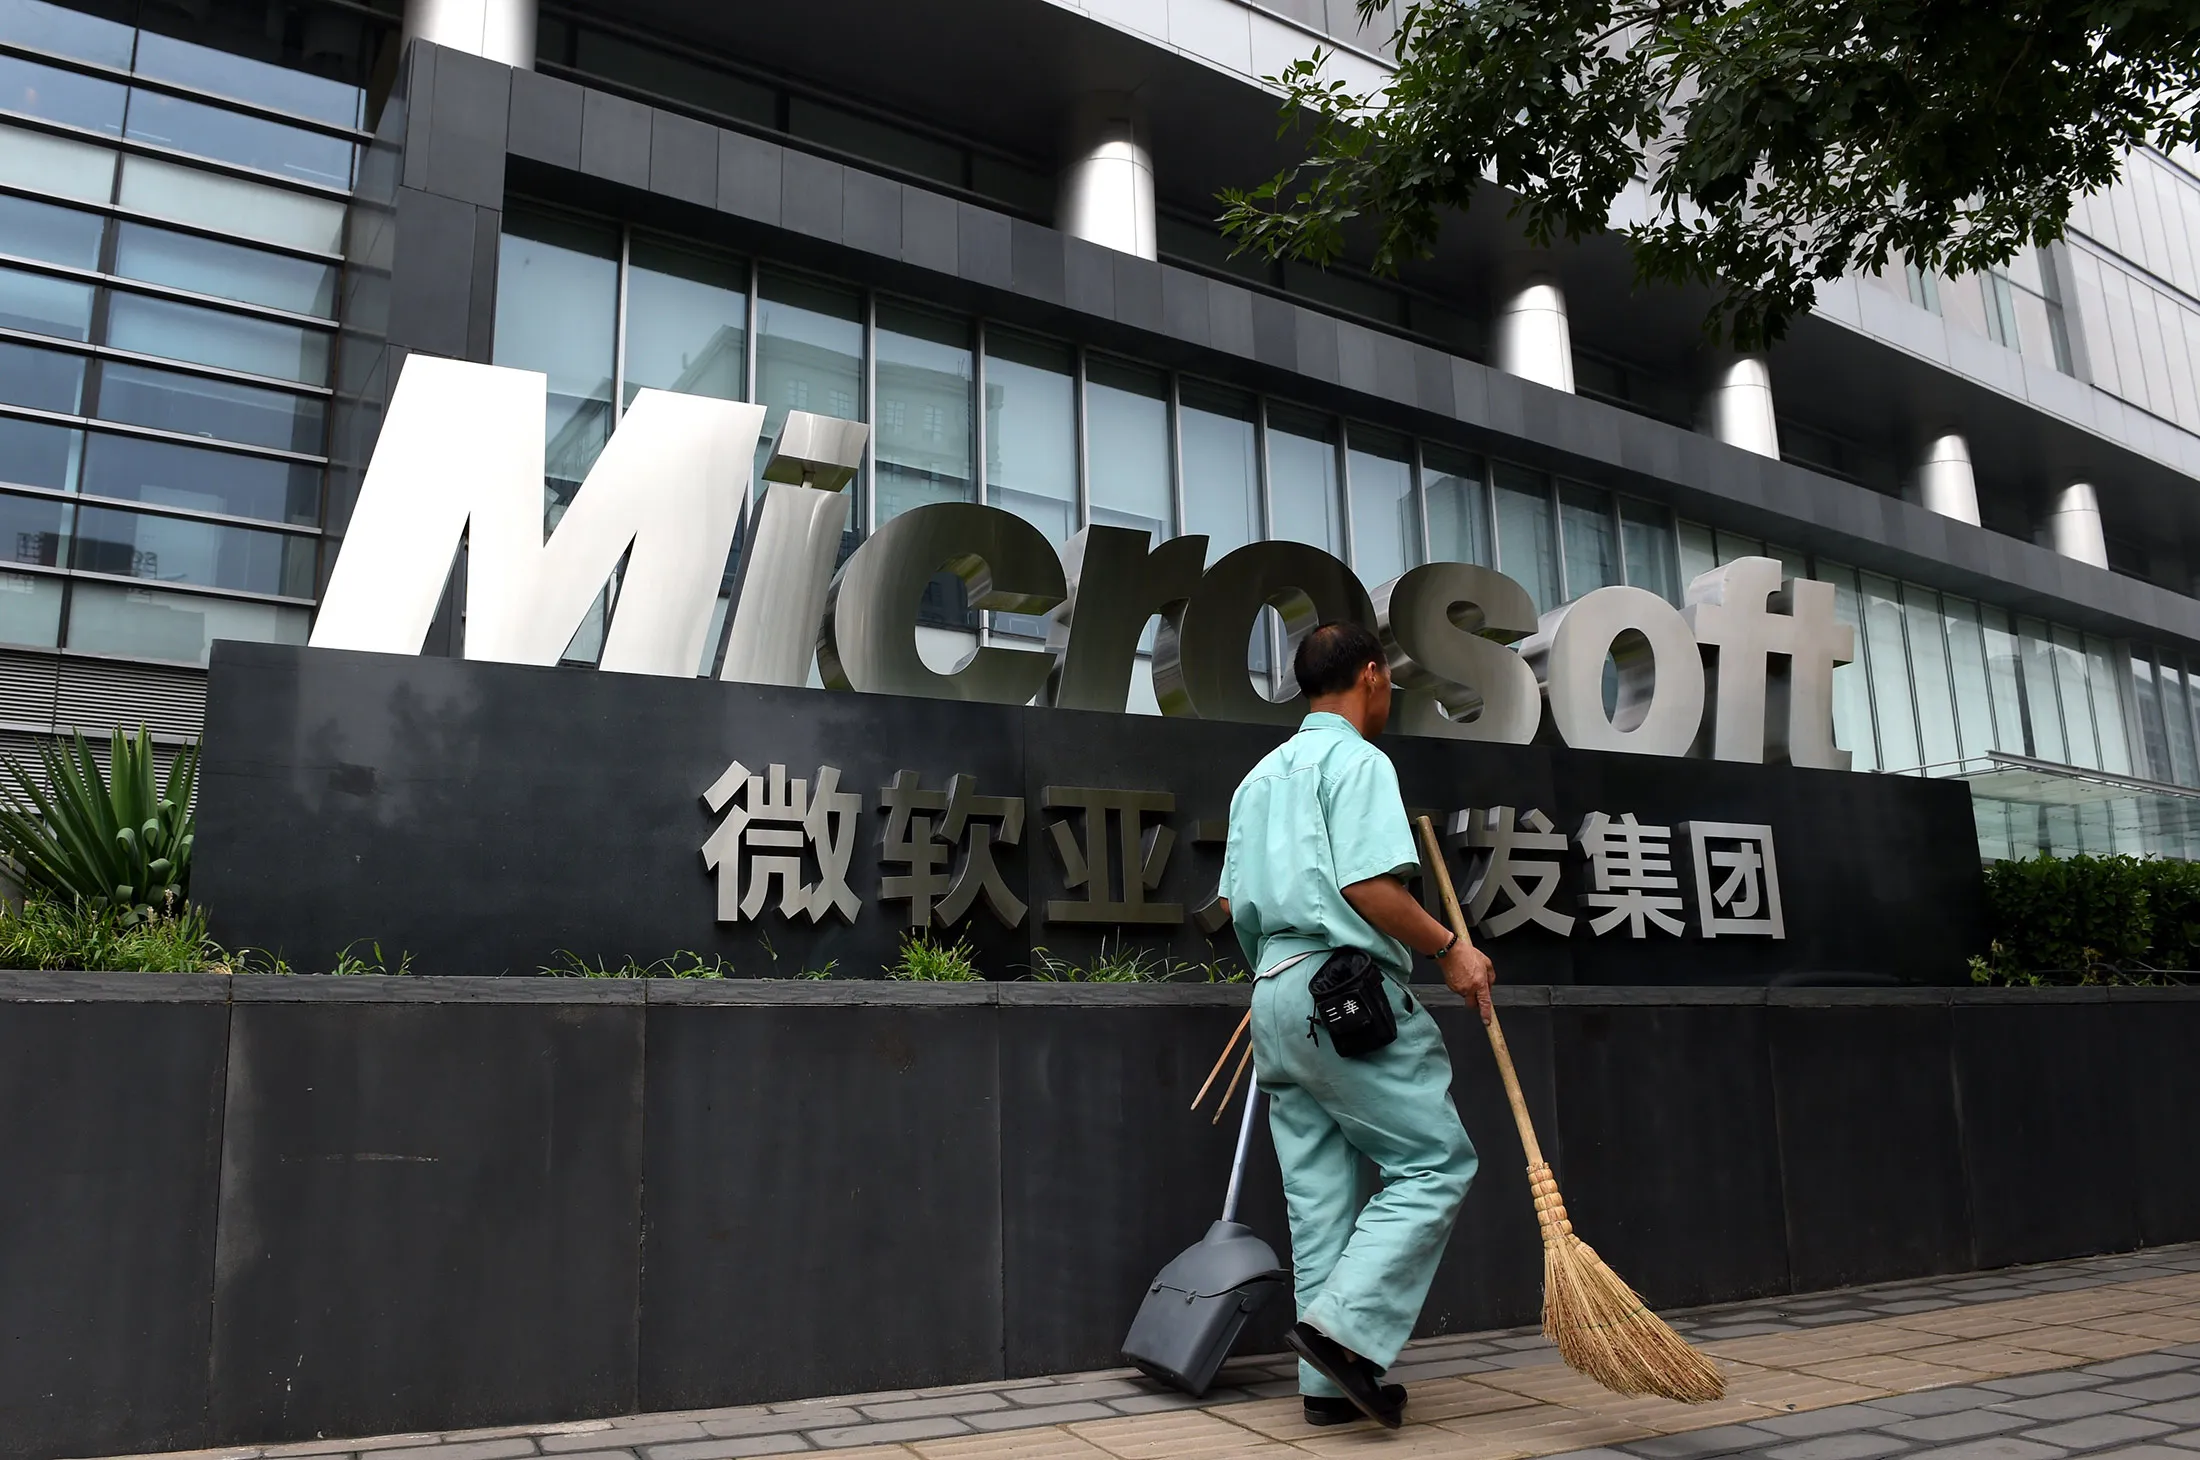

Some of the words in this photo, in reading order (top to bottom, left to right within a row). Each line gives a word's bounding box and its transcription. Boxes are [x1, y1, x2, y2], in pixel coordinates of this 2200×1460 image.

[308, 353, 1854, 772] Microsoft
[700, 760, 1786, 941] 微软亚发集团
